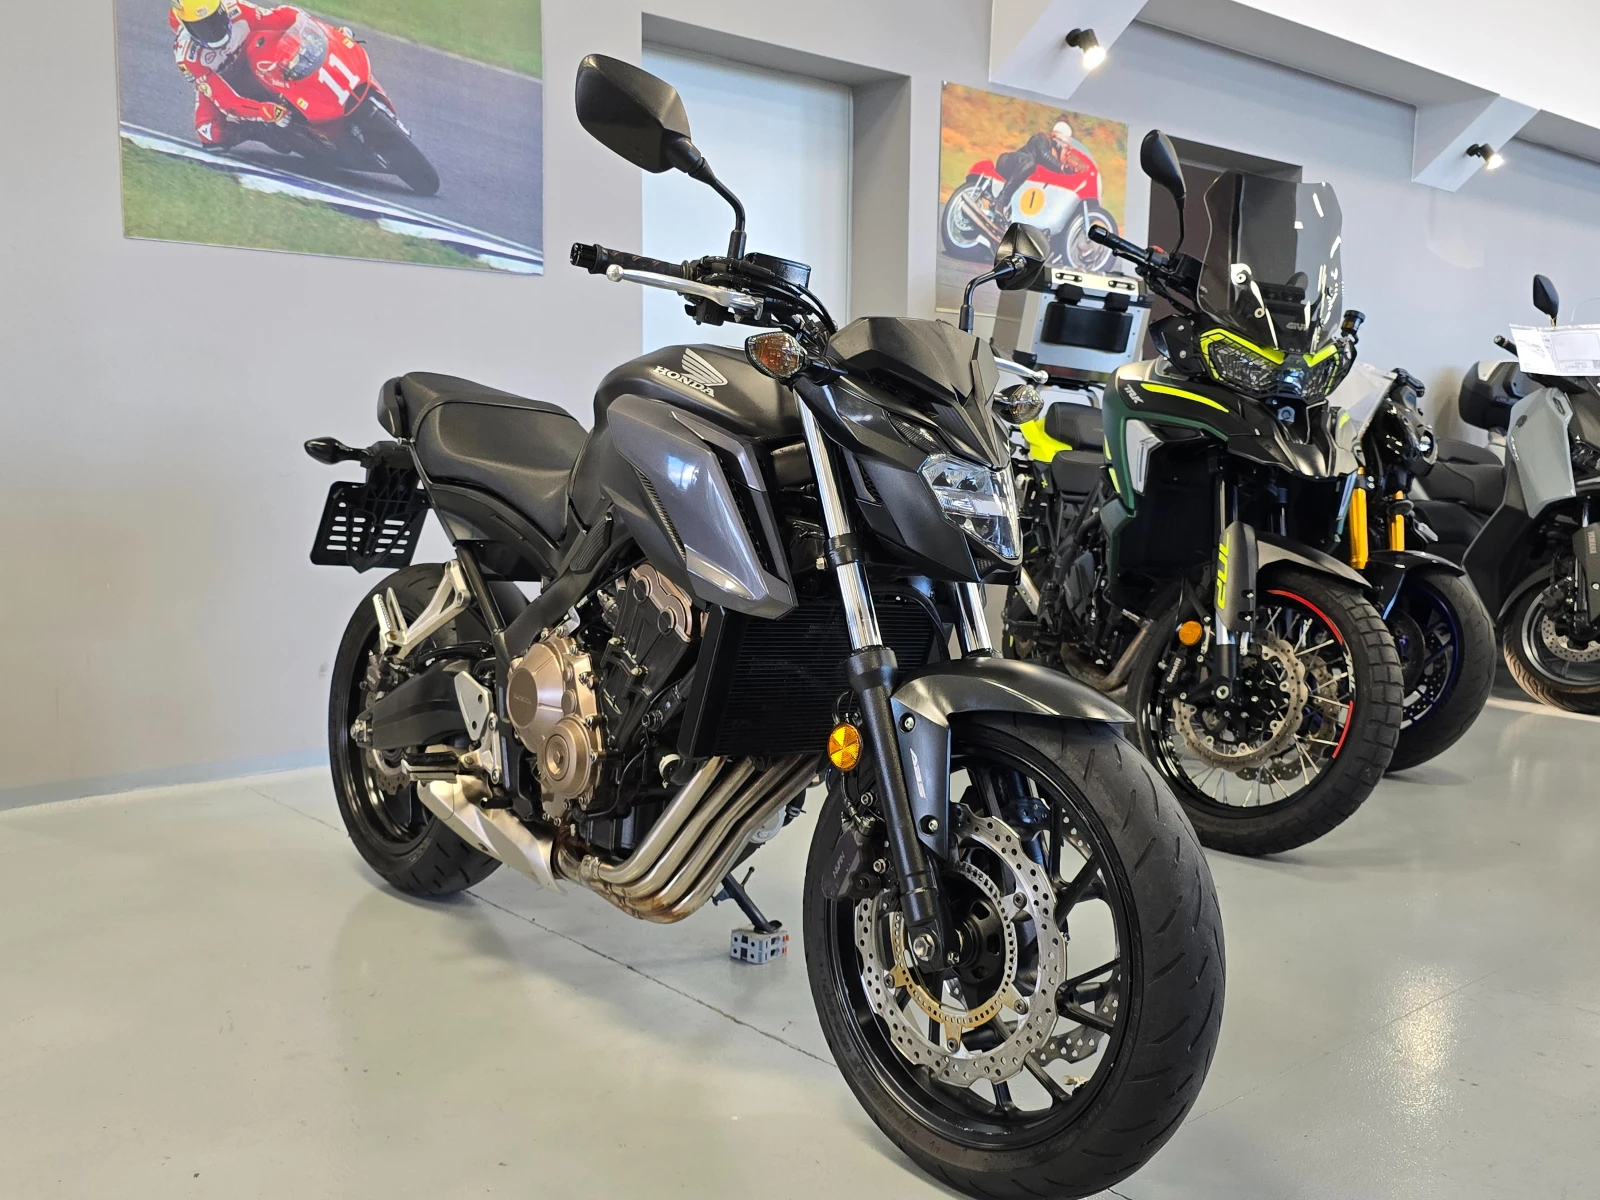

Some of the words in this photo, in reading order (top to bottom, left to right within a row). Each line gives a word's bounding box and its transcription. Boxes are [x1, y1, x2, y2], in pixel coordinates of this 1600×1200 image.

[318, 53, 360, 105] 11
[1029, 190, 1036, 209] 1
[652, 365, 714, 398] HONDA
[1123, 383, 1144, 404] TRK
[1587, 530, 1597, 554] YAMAHA
[1166, 657, 1182, 683] Benelli
[909, 747, 926, 799] ABS
